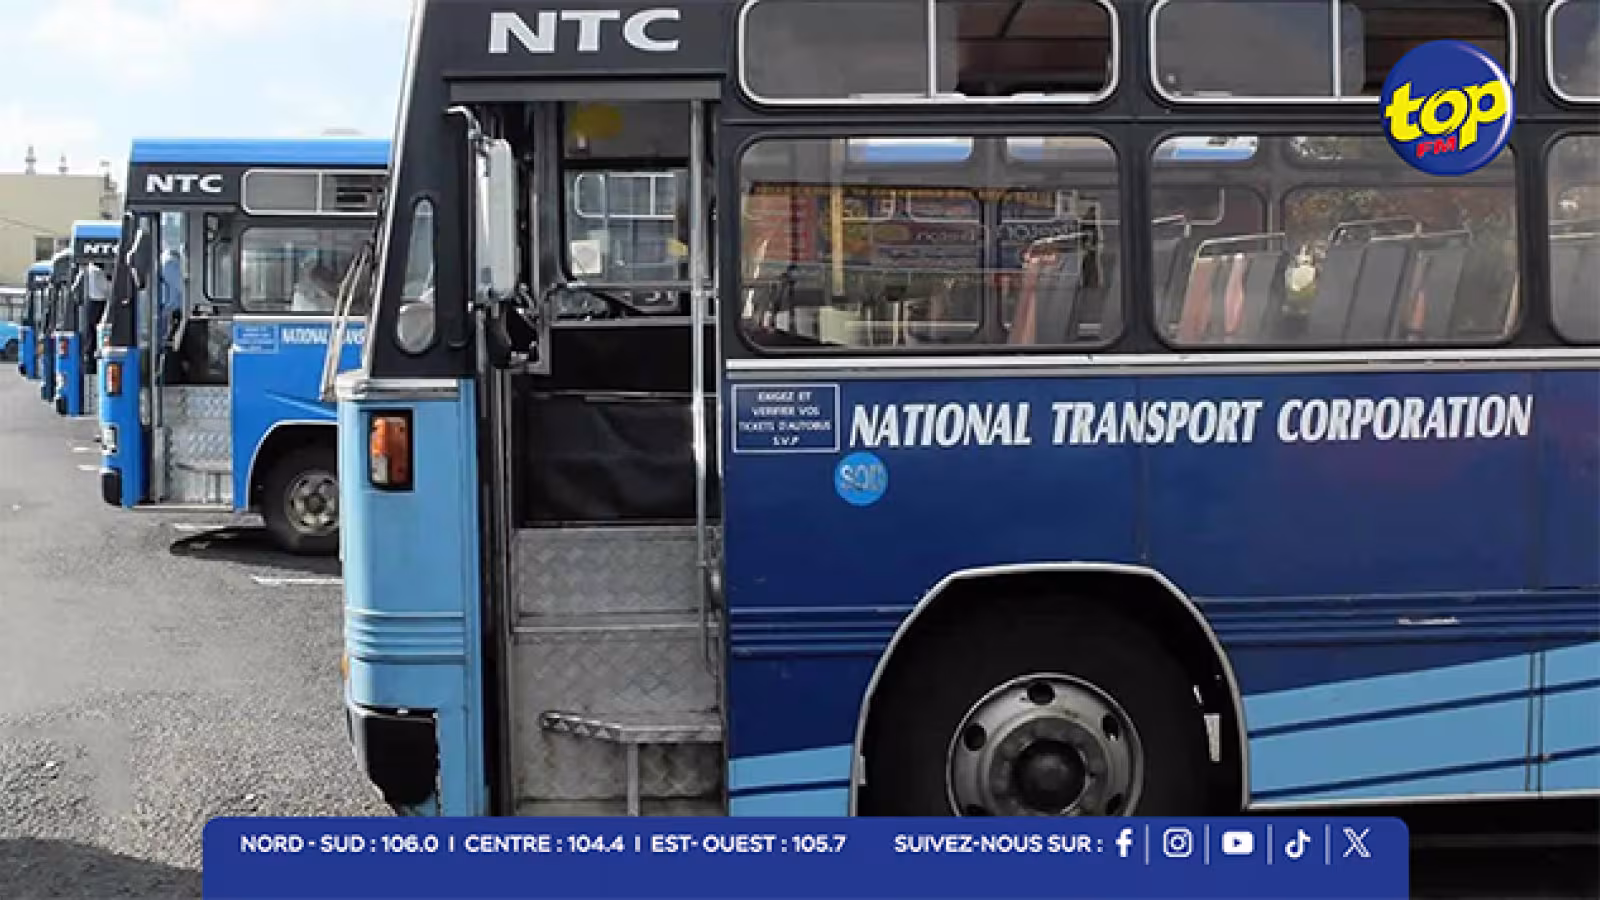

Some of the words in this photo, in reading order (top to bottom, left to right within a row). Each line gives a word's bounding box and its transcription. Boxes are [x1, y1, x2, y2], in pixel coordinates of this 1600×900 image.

[488, 8, 681, 53] NTC
[146, 173, 224, 193] NTC
[798, 391, 813, 402] ET
[798, 405, 821, 416] VOS
[849, 402, 1033, 448] NATIONAL
[1051, 400, 1264, 446] TRANSPORT
[1276, 395, 1534, 443] CORPORATION
